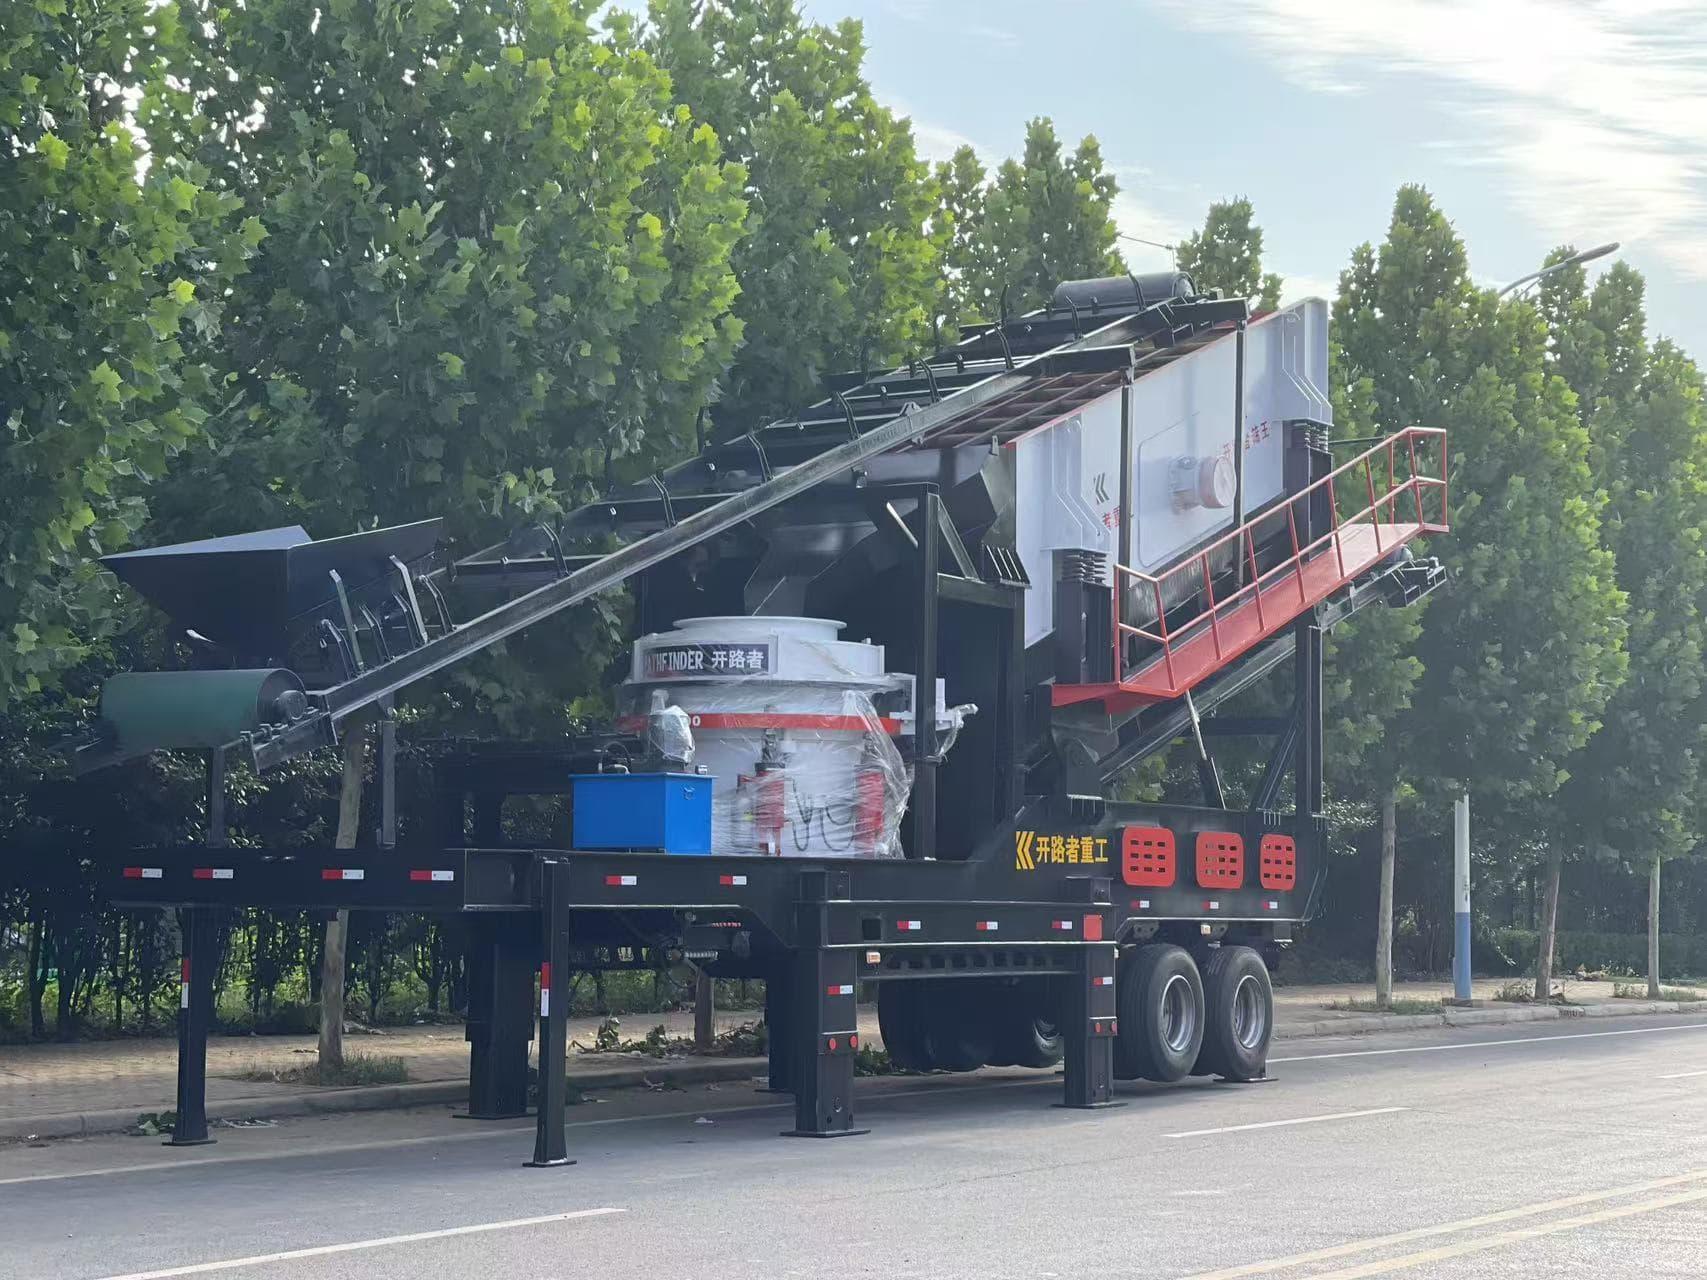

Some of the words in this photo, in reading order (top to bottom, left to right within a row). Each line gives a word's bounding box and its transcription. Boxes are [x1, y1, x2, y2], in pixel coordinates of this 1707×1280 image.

[644, 650, 703, 672] ATHFINDER
[711, 649, 764, 670] 开路者
[1036, 835, 1108, 863] 开路者重工
